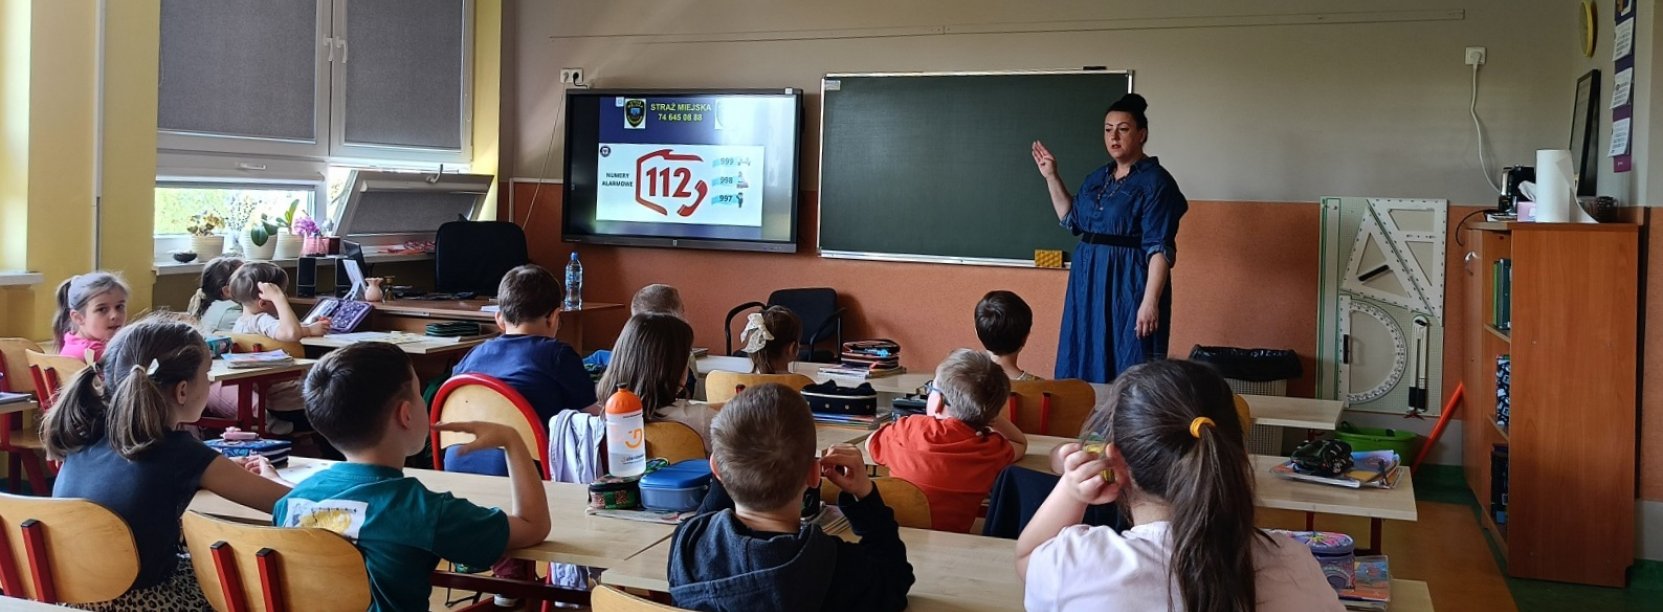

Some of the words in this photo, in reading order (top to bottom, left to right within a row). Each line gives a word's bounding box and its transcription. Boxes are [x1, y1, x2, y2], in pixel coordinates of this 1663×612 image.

[650, 102, 675, 111] STRAŻ
[677, 103, 711, 111] MIEJSKA
[658, 113, 666, 121] 74
[646, 166, 692, 198] 112
[720, 176, 733, 184] 998
[719, 194, 733, 202] 997
